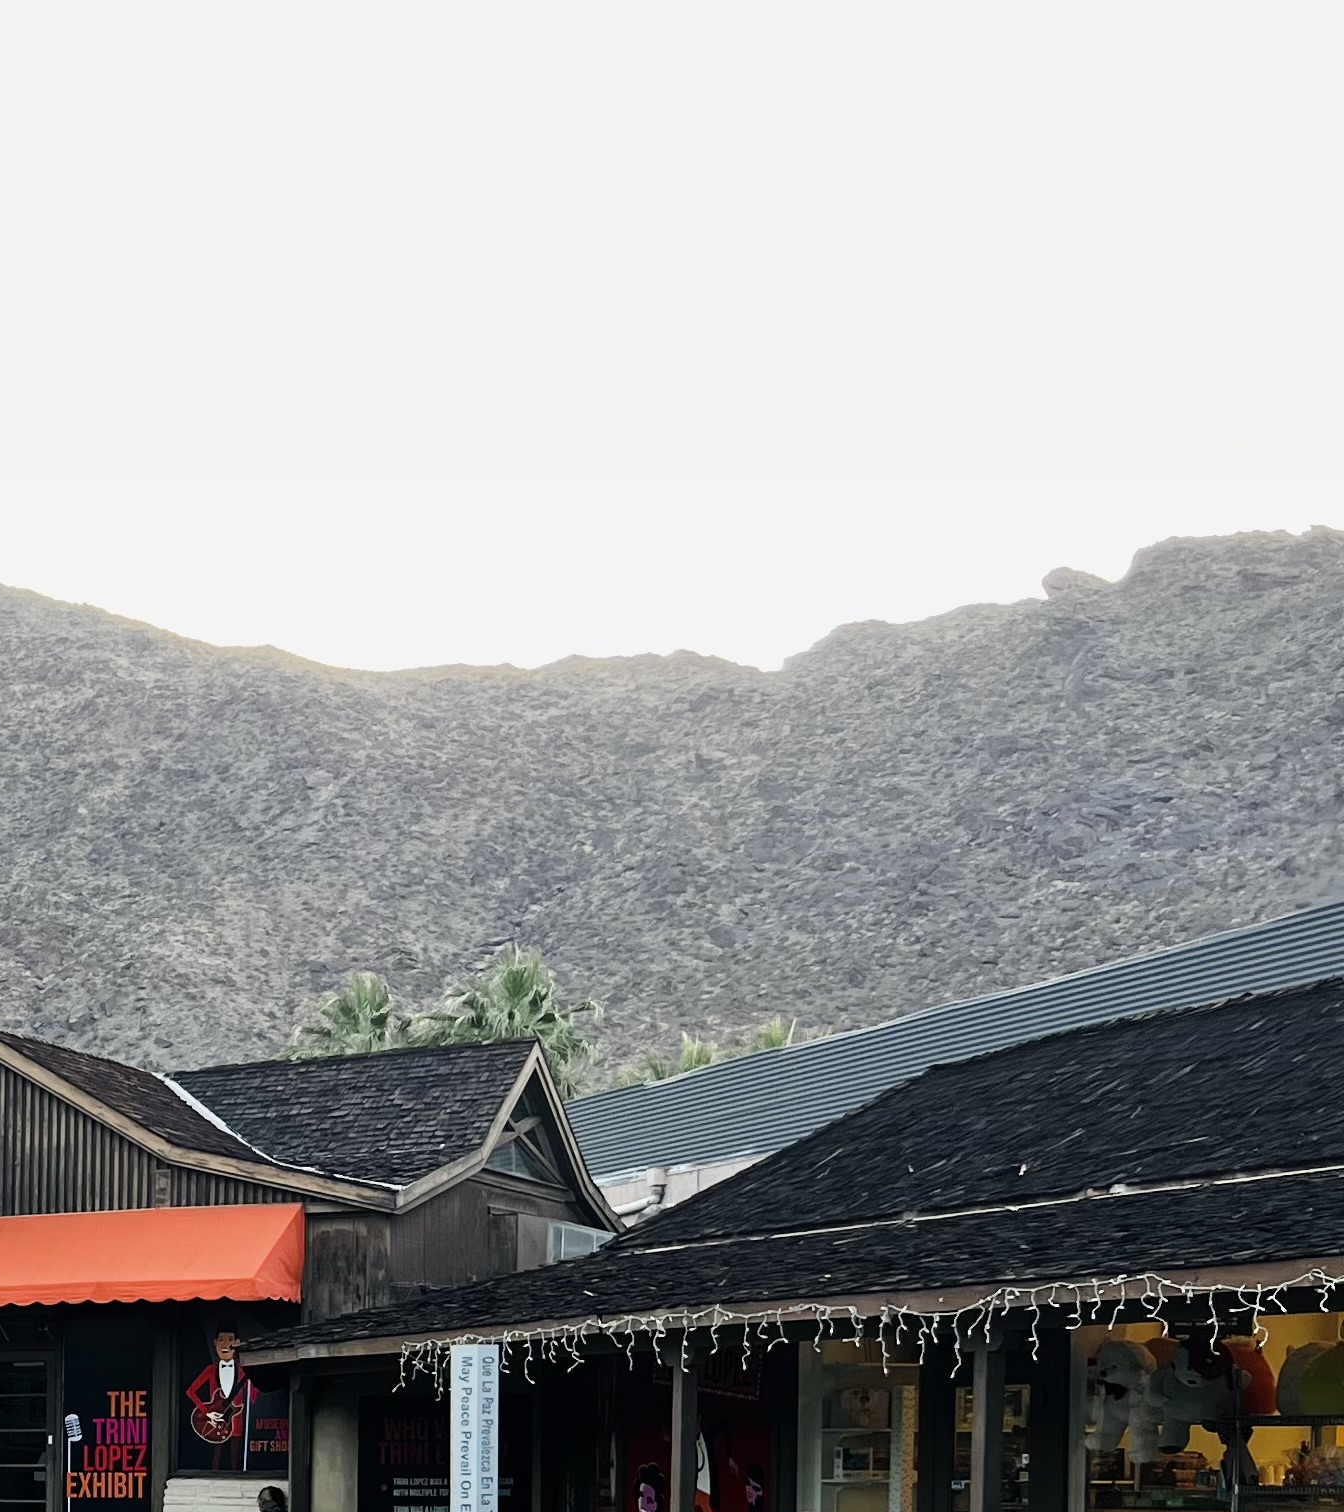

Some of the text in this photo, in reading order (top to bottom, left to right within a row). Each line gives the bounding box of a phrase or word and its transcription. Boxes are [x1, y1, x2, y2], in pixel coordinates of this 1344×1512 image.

[459, 1356, 473, 1383] May
[481, 1356, 494, 1377] Que
[481, 1381, 493, 1393] La
[107, 1390, 147, 1417] THE
[461, 1387, 472, 1426] Peace
[481, 1397, 493, 1415] Paz
[92, 1418, 147, 1444] TRINI
[83, 1445, 147, 1471] LOPEZ
[249, 1440, 289, 1452] GIFT SHO
[460, 1431, 472, 1476] Prevail
[480, 1419, 493, 1473] Prevalezca
[66, 1472, 147, 1498] EXHIBIT
[461, 1480, 472, 1499] On
[481, 1477, 493, 1489] En
[481, 1494, 493, 1506] La
